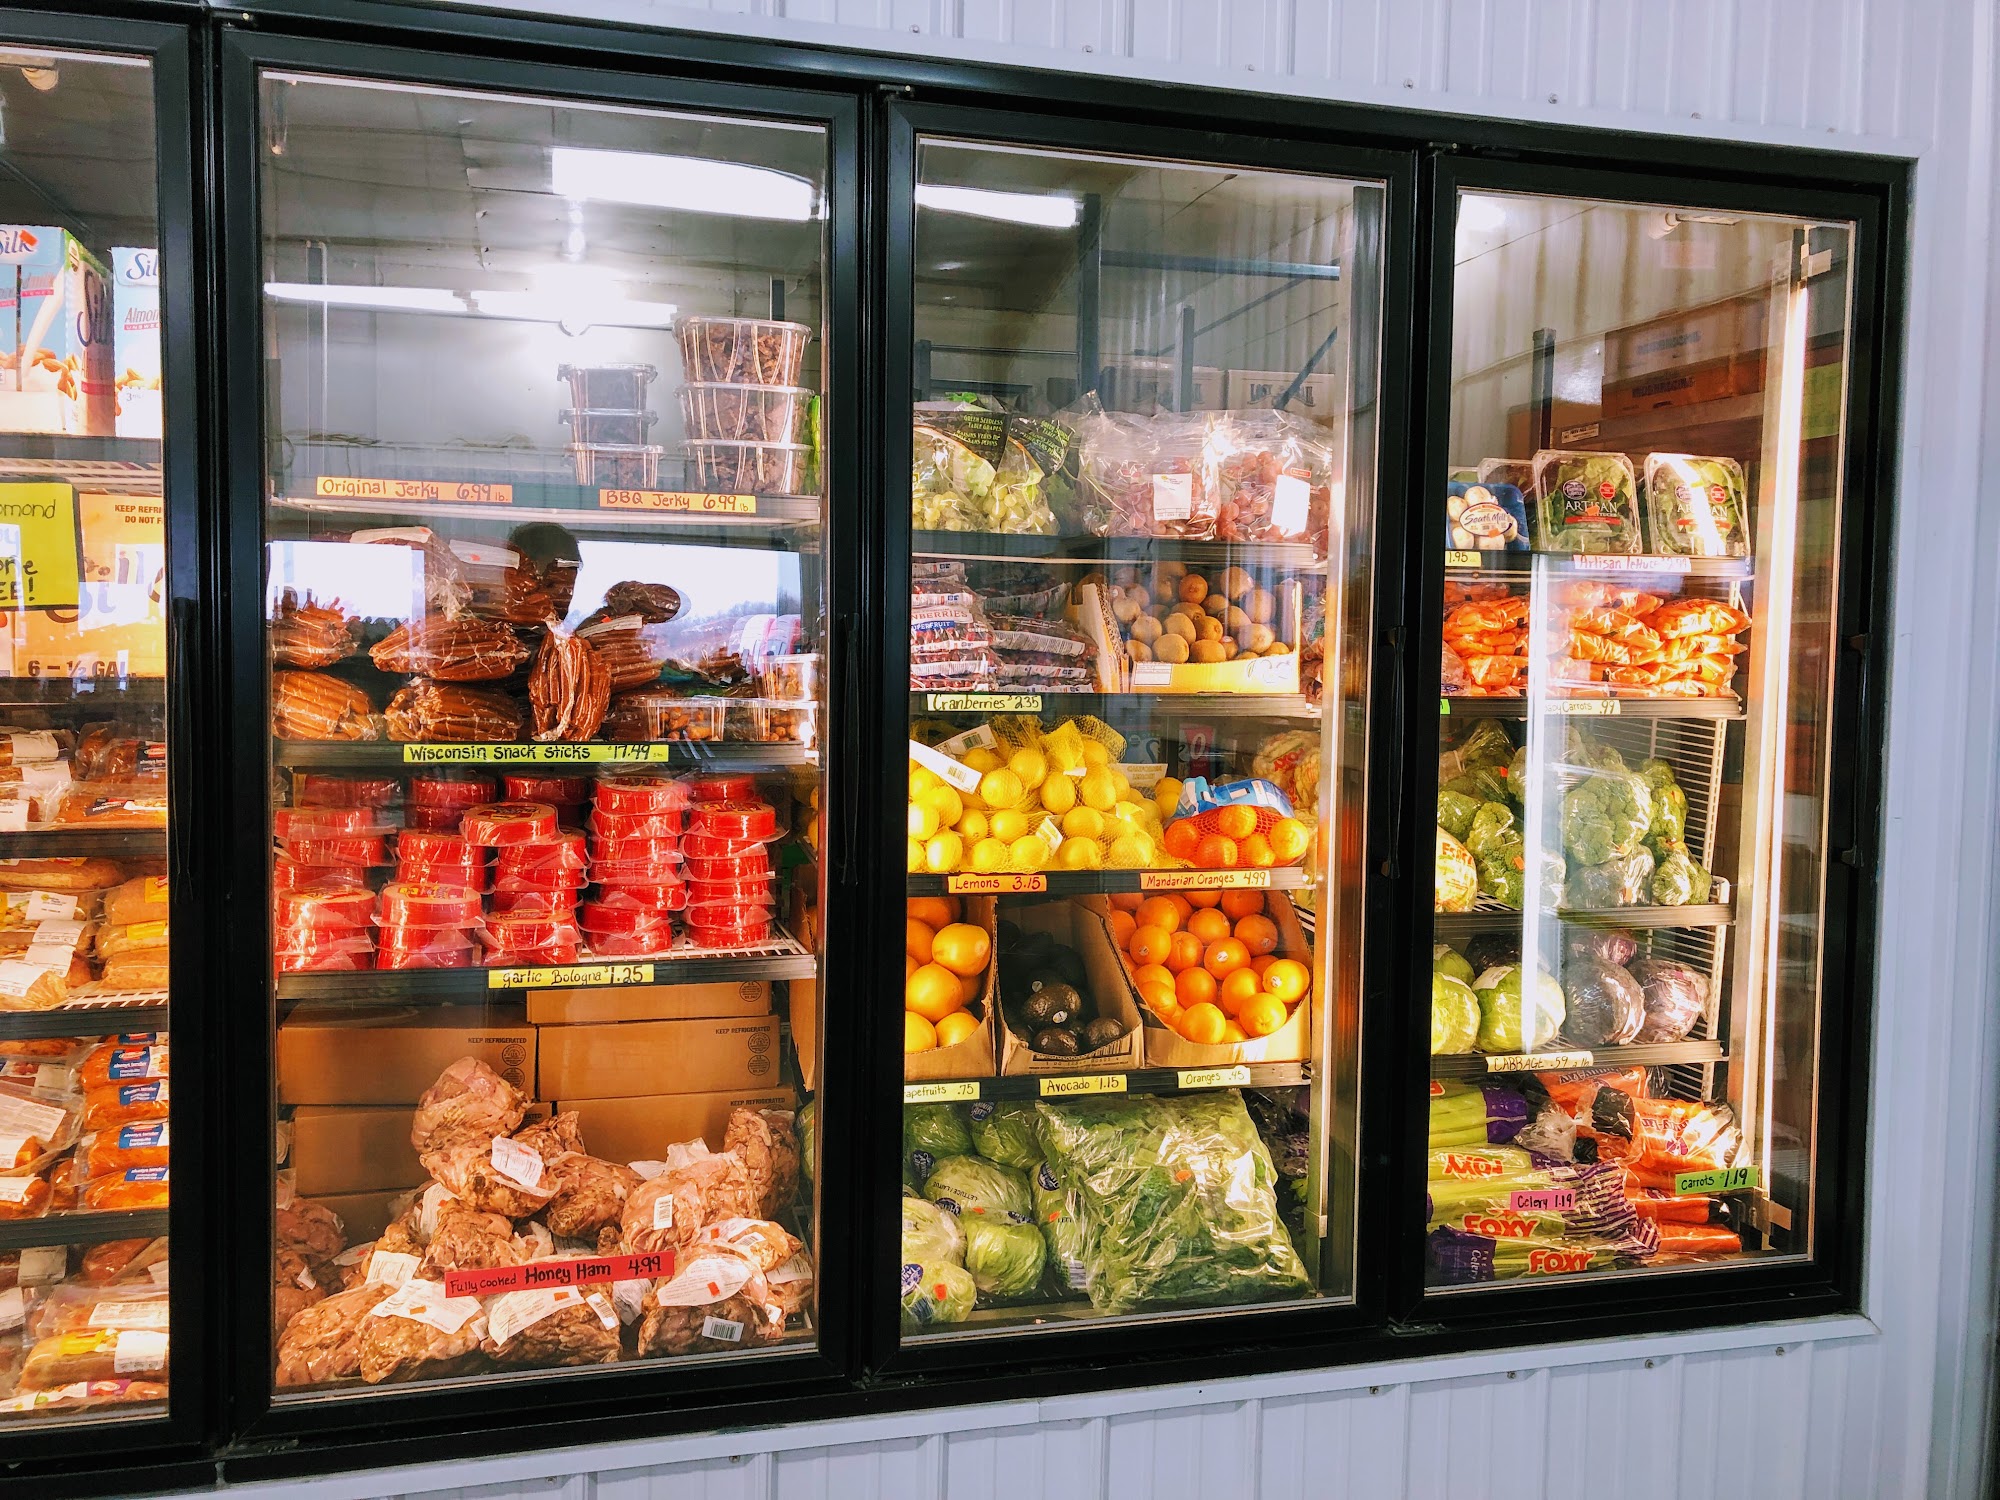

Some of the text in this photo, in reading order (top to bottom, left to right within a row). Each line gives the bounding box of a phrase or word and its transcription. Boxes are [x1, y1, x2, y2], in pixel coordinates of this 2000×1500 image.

[322, 478, 387, 497] Original
[395, 482, 439, 499] Jerky
[456, 482, 492, 501] 6.99
[114, 504, 136, 512] KEEP
[606, 490, 643, 504] BBQ
[652, 493, 690, 509] Jerky
[703, 493, 737, 511] 6.99
[124, 515, 137, 523] DO
[138, 516, 155, 524] NOT
[1464, 512, 1490, 526] South
[1449, 551, 1469, 563] 1.95
[28, 660, 41, 677] 6
[932, 693, 1006, 711] Cranberries
[1562, 701, 1593, 713] Carrots
[408, 745, 487, 761] Wisconsin
[493, 744, 536, 760] Snack
[543, 744, 591, 760] Sticks
[955, 876, 1041, 890] Lemons 3.15
[1146, 871, 1267, 888] Mandarian Oranges 4.99
[551, 969, 602, 985] Bologna
[731, 1025, 771, 1033] REFRIGERATED
[1494, 1056, 1545, 1071] CABBAGE
[1046, 1079, 1091, 1094] Avocado
[1185, 1072, 1221, 1085] Oranges
[957, 1083, 974, 1096] .75
[1681, 1174, 1715, 1191] Carrots
[1517, 1193, 1573, 1209] Celery 1.19
[1463, 1214, 1539, 1238] FOXY
[1529, 1250, 1596, 1274] FOXY
[449, 1279, 479, 1295] Fully
[525, 1266, 571, 1284] Honey
[576, 1262, 611, 1279] Ham
[627, 1255, 662, 1277] 4.99
